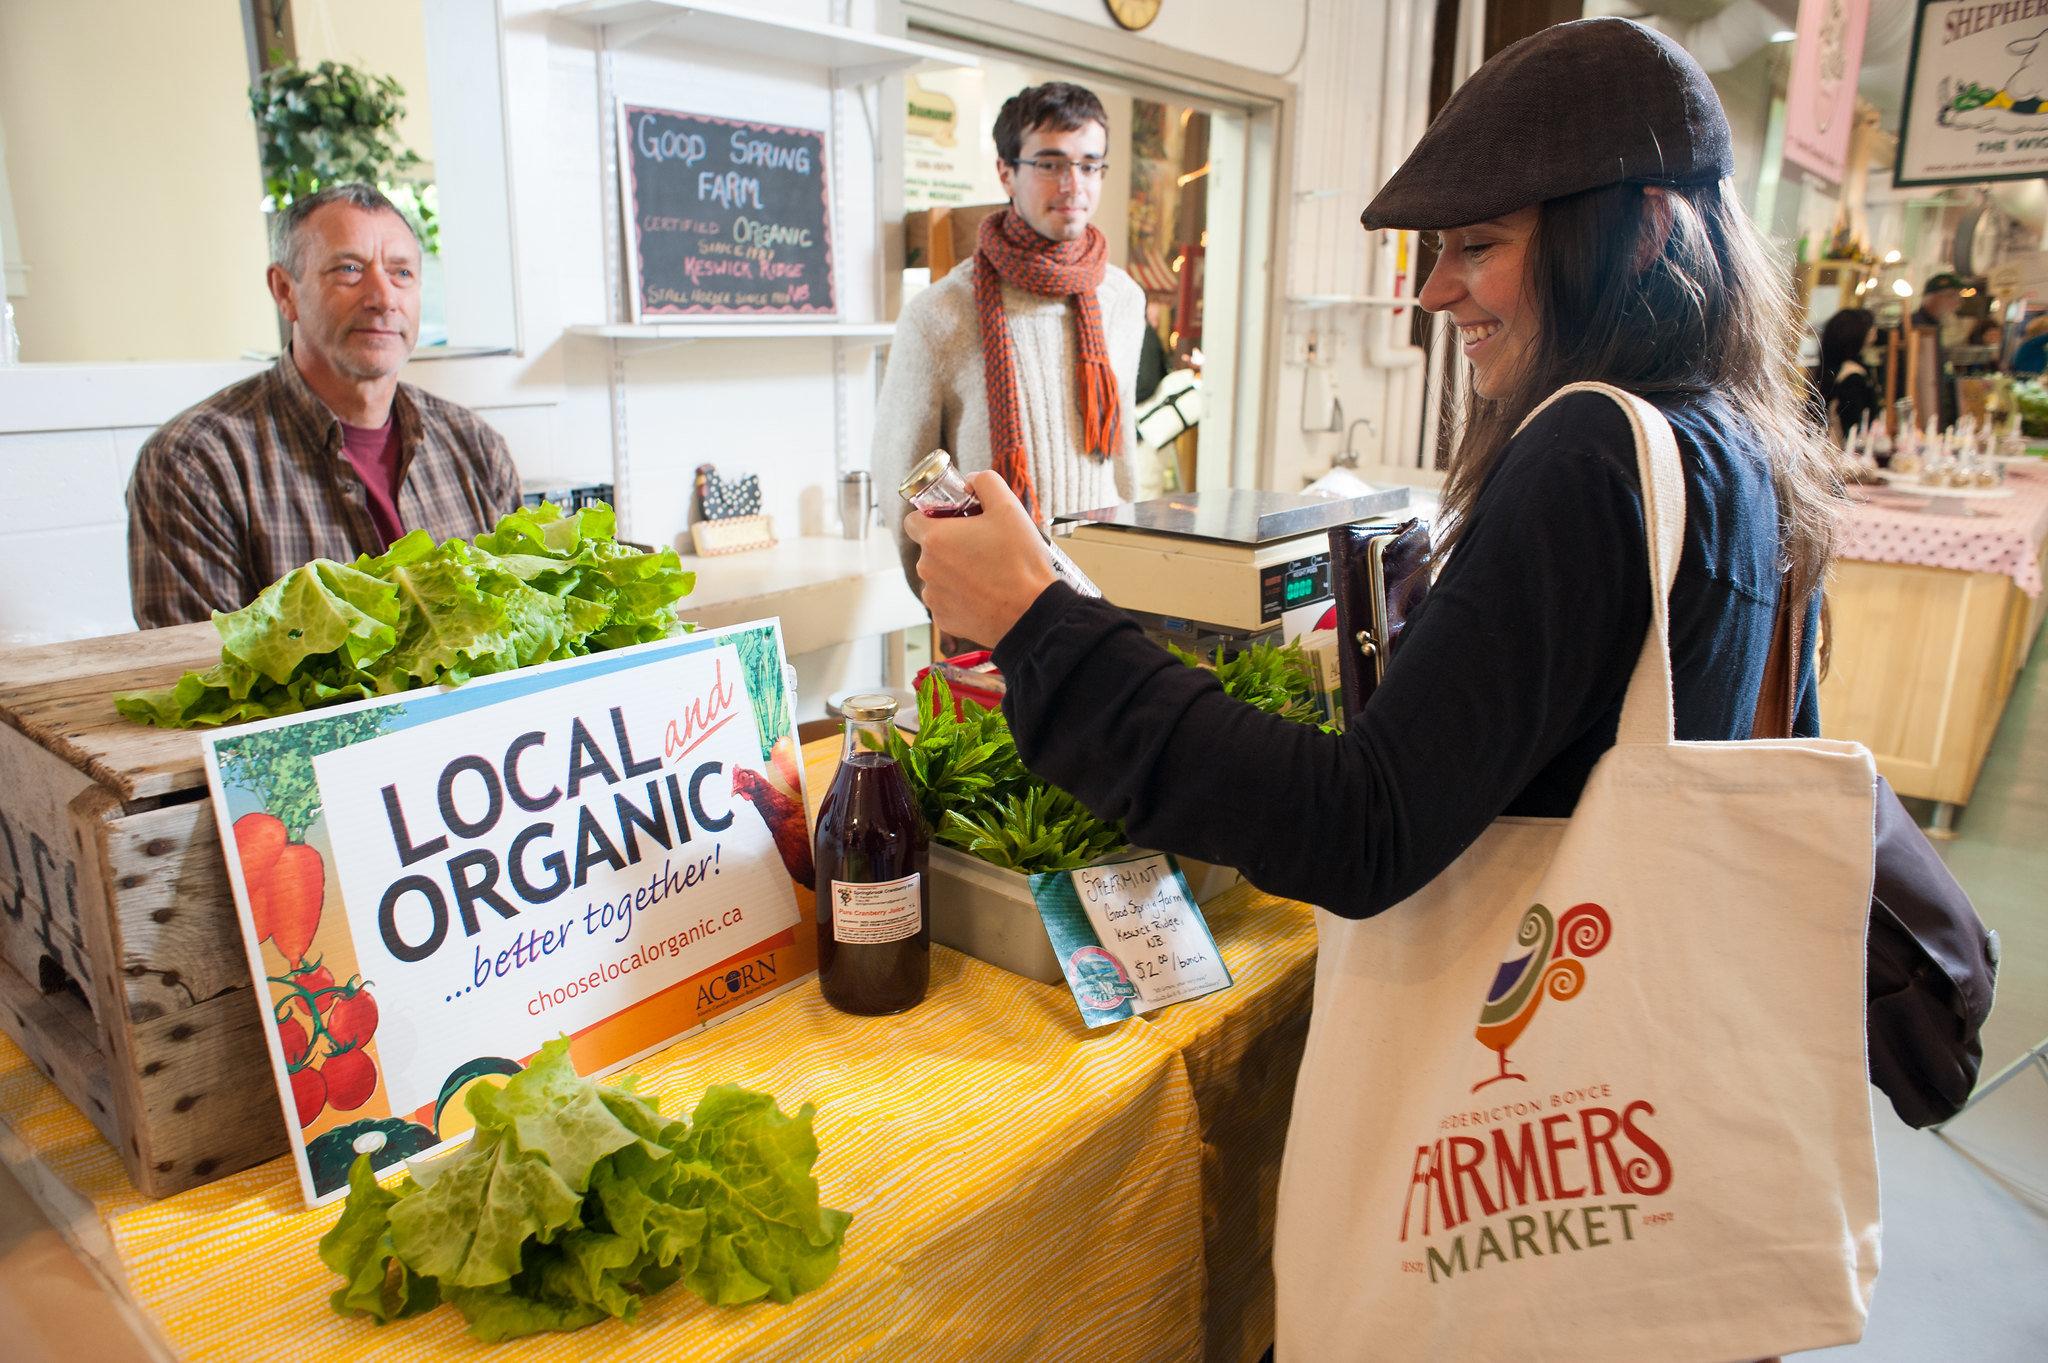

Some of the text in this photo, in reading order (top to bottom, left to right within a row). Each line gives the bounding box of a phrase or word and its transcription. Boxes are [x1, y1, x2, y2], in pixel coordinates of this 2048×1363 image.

[638, 114, 811, 175] GOOD SPRING
[698, 171, 764, 209] FARM
[643, 215, 813, 247] CERTIFIED ORGANIC
[697, 239, 744, 257] SINCE
[684, 256, 806, 285] KESWICK RIDGE
[380, 658, 734, 868] LOCAL and
[378, 761, 735, 963] ORGANIC
[583, 842, 722, 944] together!
[1081, 864, 1158, 902] SPEARMINT
[854, 909, 887, 917] Cranberry
[888, 905, 905, 914] Juice
[1104, 890, 1182, 922] Good Spring Farm
[1114, 926, 1151, 943] Keswick
[1146, 935, 1164, 948] NB
[527, 906, 744, 1016] chooselocalorganic.ca
[1549, 1084, 1613, 1108] BOYCE
[1399, 1100, 1673, 1242] FARMERS
[1426, 1203, 1638, 1283] MARKET
